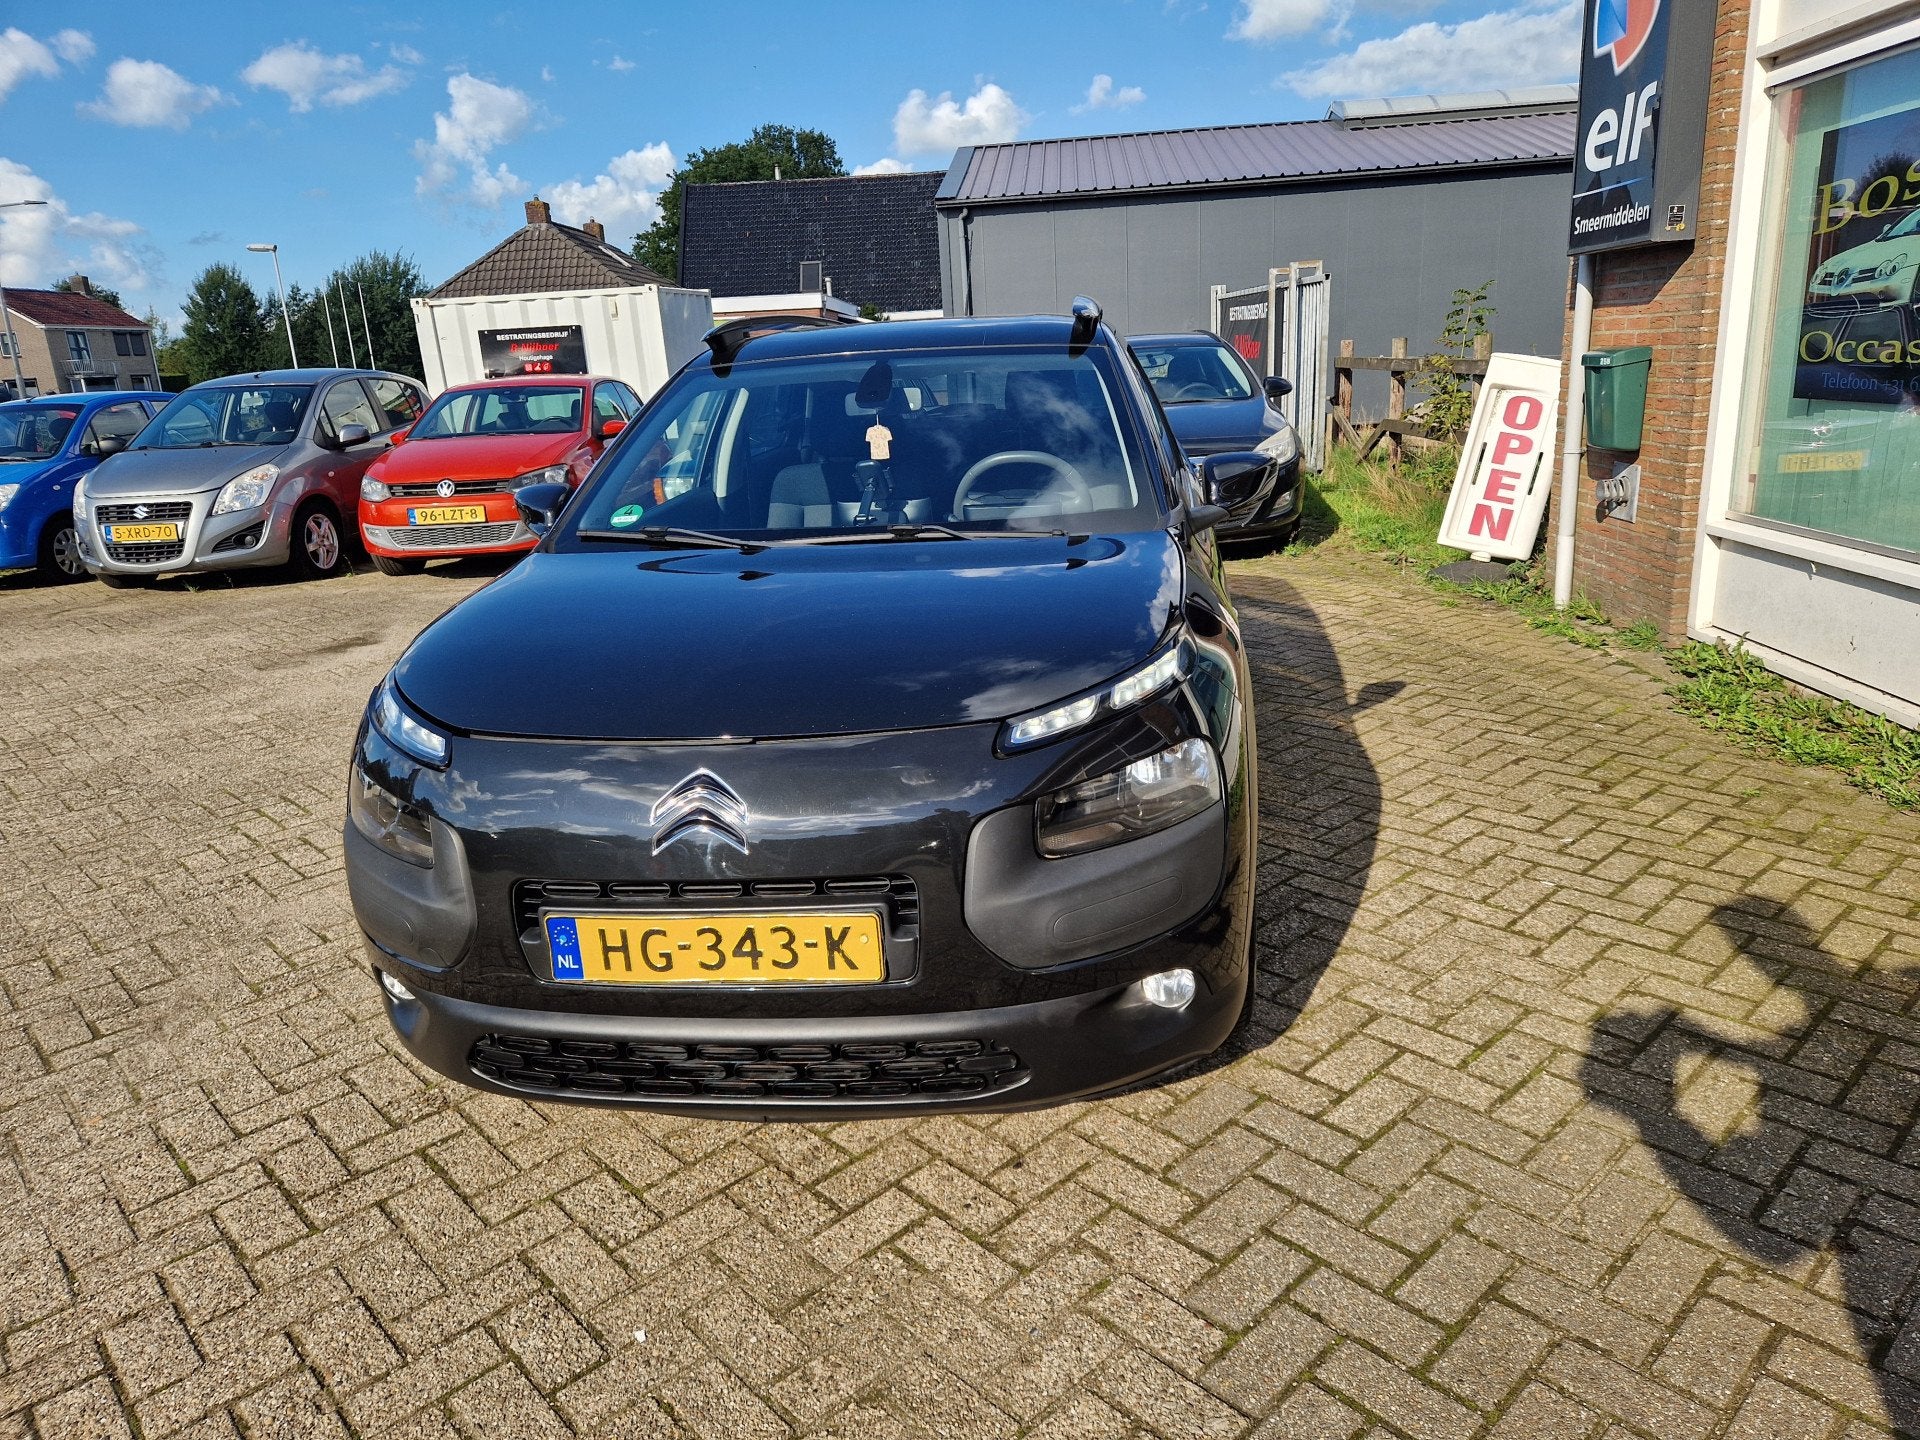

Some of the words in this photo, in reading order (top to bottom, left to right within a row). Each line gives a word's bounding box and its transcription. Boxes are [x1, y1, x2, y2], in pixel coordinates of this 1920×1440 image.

[1584, 81, 1658, 172] elf
[1574, 202, 1650, 235] Smeermiddelen
[496, 331, 569, 341] BESTRATINGSBEDRIJF
[1800, 330, 1920, 363] Occas
[1822, 372, 1877, 390] Telefoon
[1468, 395, 1543, 541] OPEN
[420, 508, 478, 522] 96-LZT-8
[624, 505, 634, 515] 4
[114, 526, 172, 539] 5-XRD-70
[598, 926, 859, 972] HG-343-K
[557, 954, 579, 969] NL
